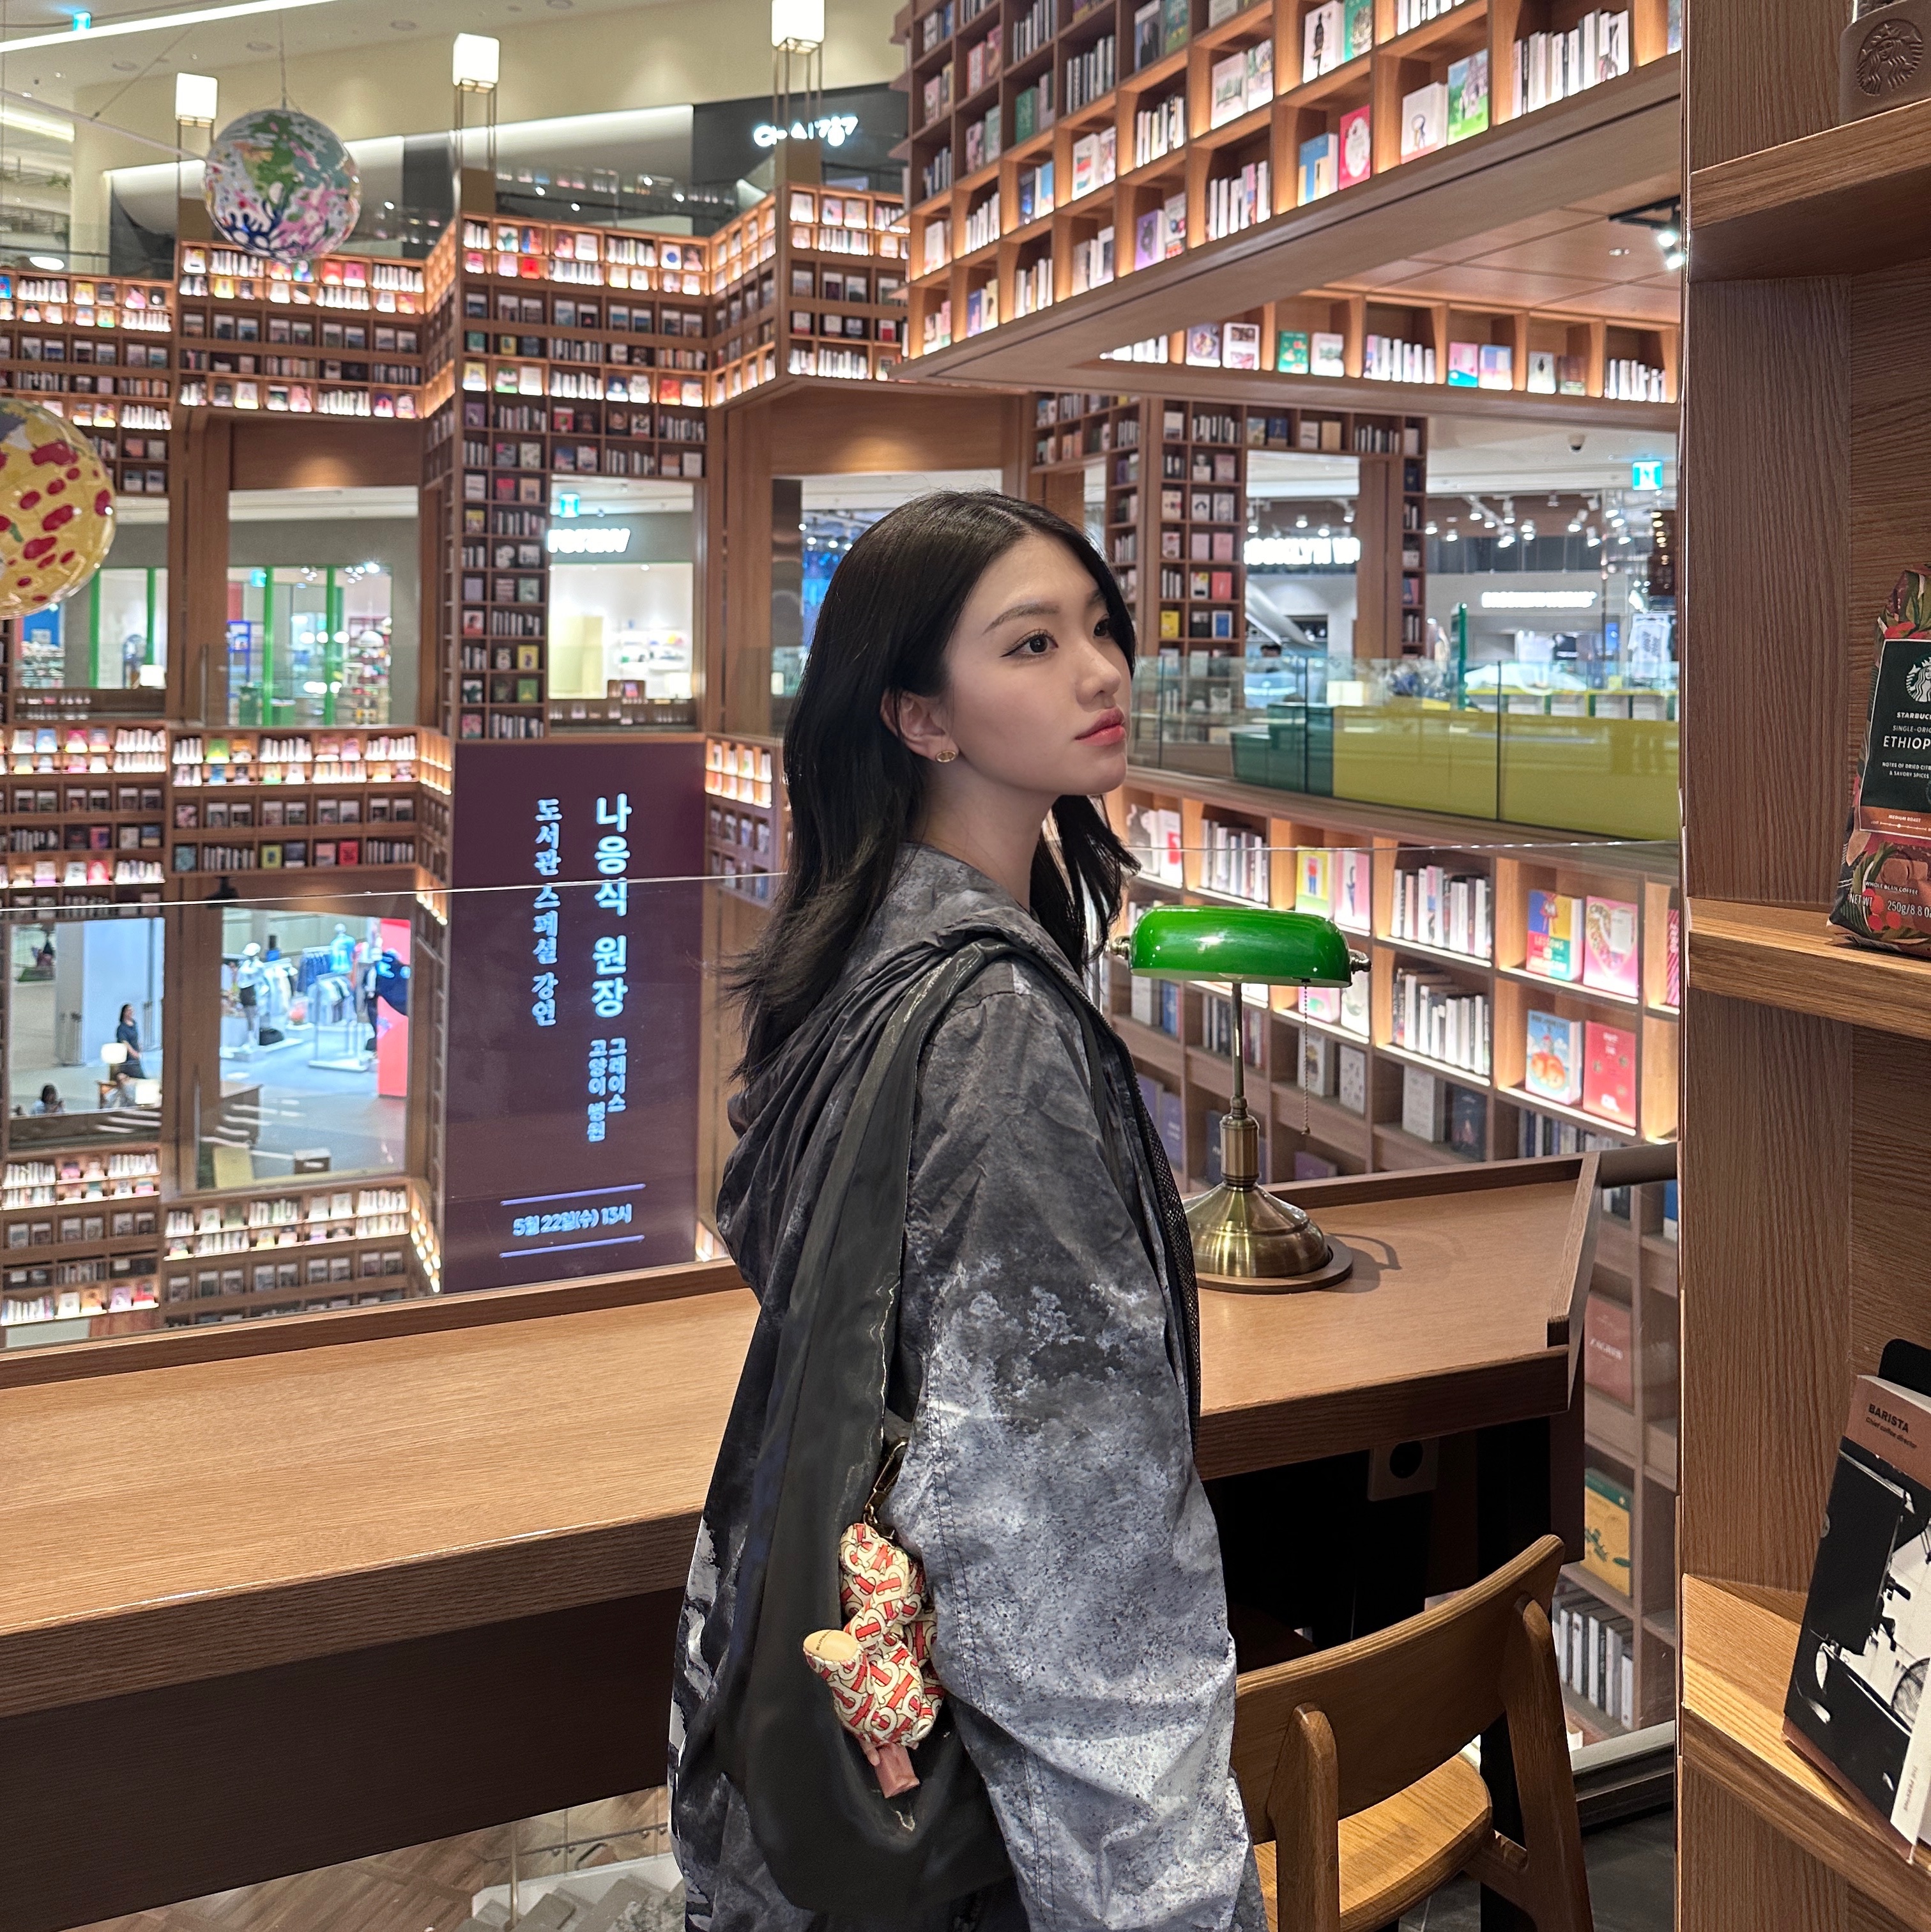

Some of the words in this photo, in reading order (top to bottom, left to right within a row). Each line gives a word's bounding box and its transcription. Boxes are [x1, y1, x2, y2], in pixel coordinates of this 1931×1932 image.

[533, 799, 563, 876] 도서관
[595, 793, 632, 917] 나응식
[1849, 893, 1861, 904] NET
[1863, 896, 1873, 907] WT
[1898, 887, 1918, 895] COFFEE
[533, 885, 561, 965] 스페셜
[531, 971, 559, 1026] 강연
[592, 935, 629, 1018] 원장
[588, 1039, 607, 1096] 고양이
[607, 1037, 627, 1113] 그레이스
[587, 1101, 606, 1142] 병원
[512, 1215, 540, 1237] 5월
[1868, 1403, 1909, 1433] BARISTA
